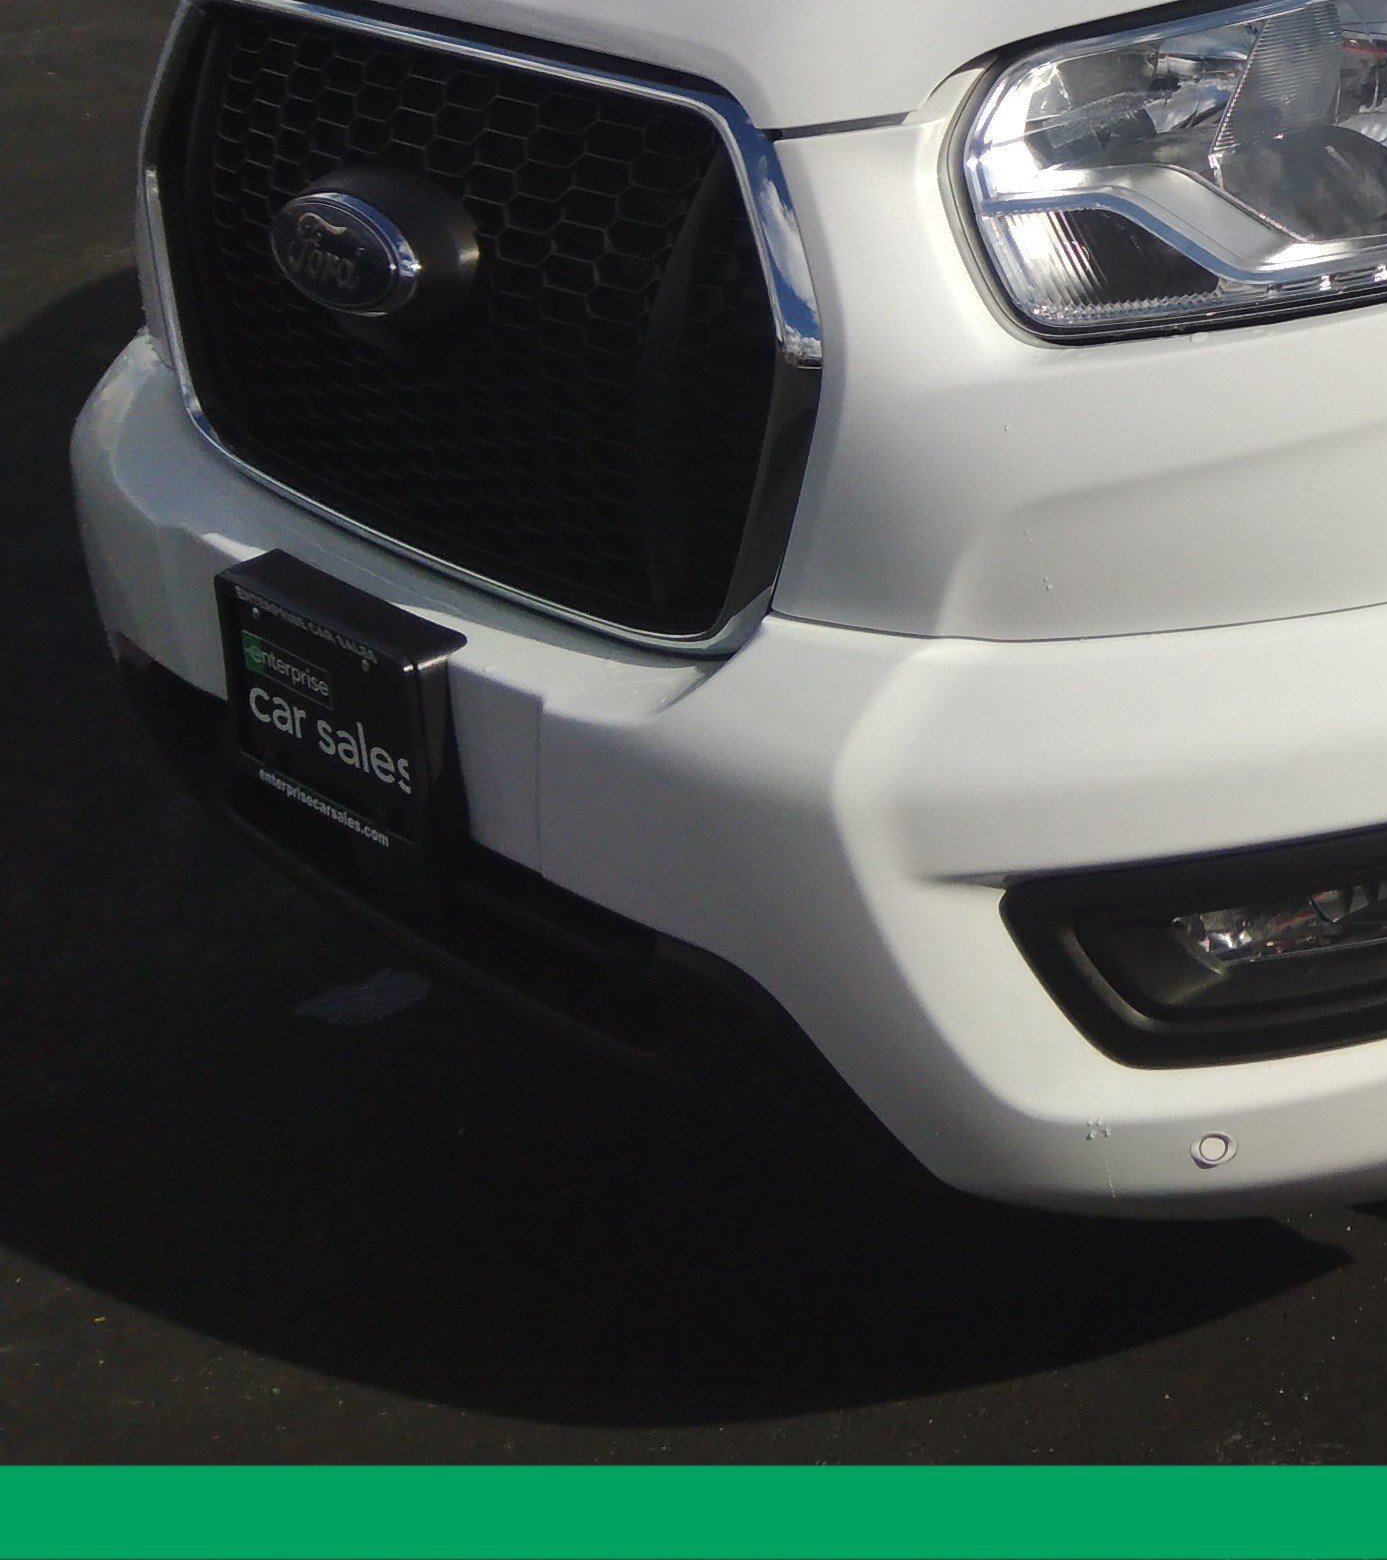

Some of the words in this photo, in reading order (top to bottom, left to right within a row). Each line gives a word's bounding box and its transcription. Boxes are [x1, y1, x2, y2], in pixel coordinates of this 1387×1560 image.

[245, 644, 329, 696] enterprise
[250, 687, 306, 739] car
[316, 721, 411, 794] sales
[259, 768, 390, 848] enterprisecarsales.com
